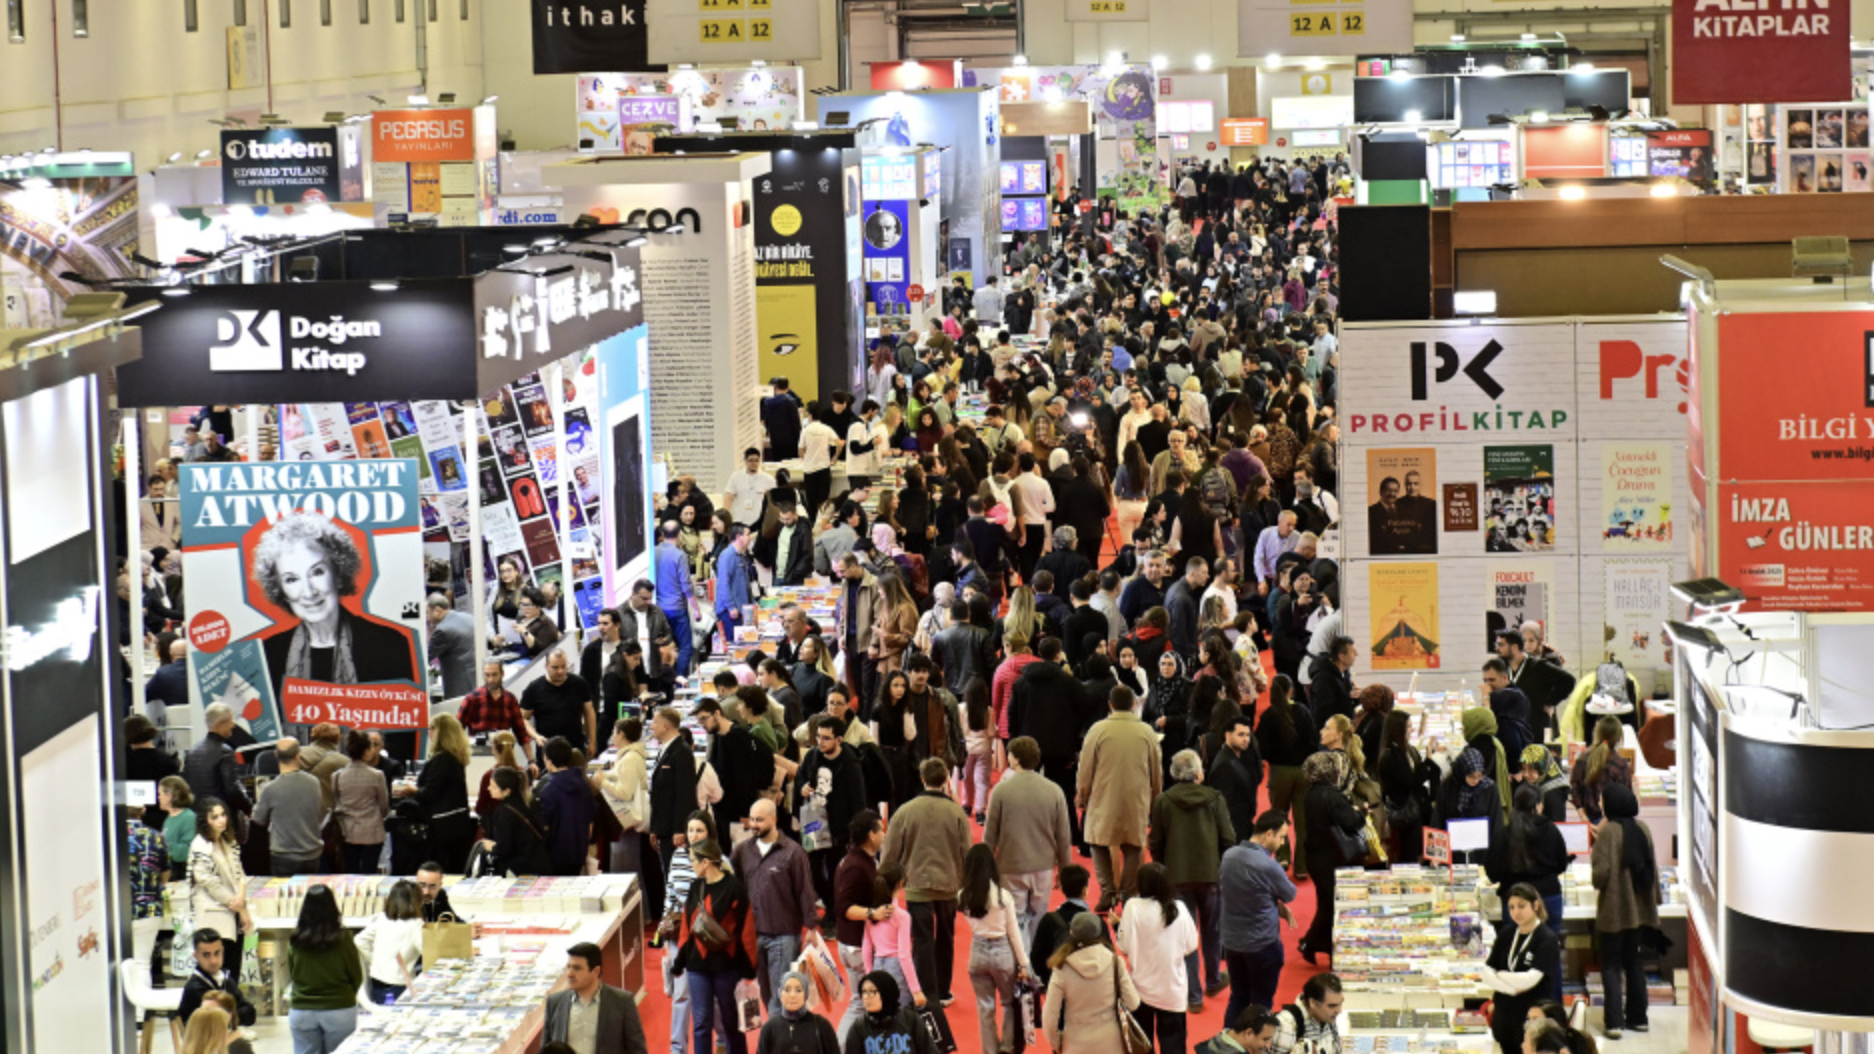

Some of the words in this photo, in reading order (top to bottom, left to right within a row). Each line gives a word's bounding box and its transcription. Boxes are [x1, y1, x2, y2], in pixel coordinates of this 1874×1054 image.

[703, 24, 720, 38] 12
[728, 23, 740, 37] A
[752, 22, 770, 37] 12
[1294, 17, 1312, 31] 12
[1320, 16, 1331, 31] A
[1344, 15, 1362, 30] 12
[621, 101, 677, 116] CEZVE
[380, 119, 465, 140] PEGASUS
[248, 138, 333, 159] tudem
[394, 141, 453, 151] YAYINLARI
[233, 167, 280, 178] EDWARD
[290, 315, 382, 344] Doğan
[291, 346, 366, 375] Kitap
[1779, 412, 1857, 440] BİLGİ
[190, 462, 406, 492] MARGARET
[193, 490, 406, 527] ATWOOD
[1732, 493, 1791, 522] İMZA
[1779, 520, 1874, 550] GÜNLER
[1496, 571, 1535, 583] FOUCAULT
[288, 684, 344, 697] DAMIZLIK
[346, 687, 378, 699] KIZIN
[379, 688, 424, 702] ÖYKÜSÜ
[290, 703, 320, 722] 40
[325, 701, 420, 729] Yaşında!
